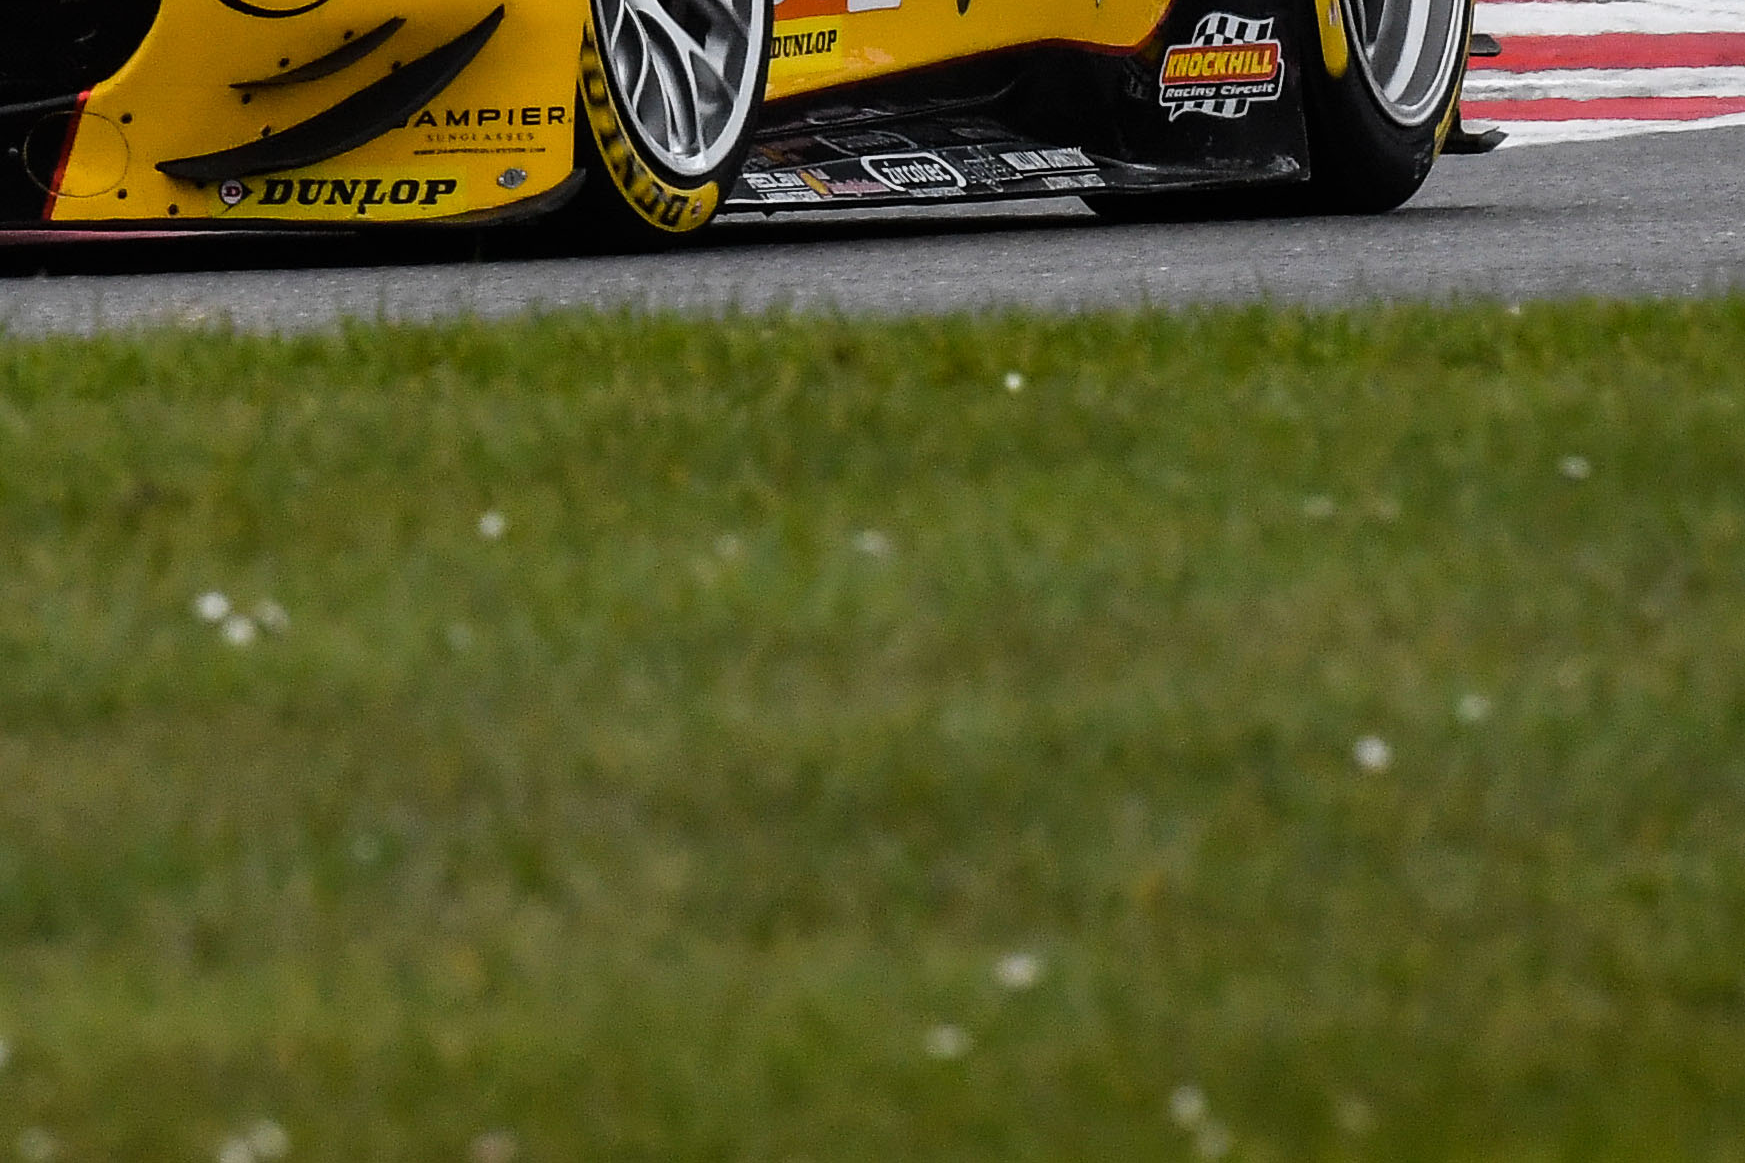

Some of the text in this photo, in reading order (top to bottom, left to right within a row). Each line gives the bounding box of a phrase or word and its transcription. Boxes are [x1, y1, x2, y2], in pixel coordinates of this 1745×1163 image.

[770, 29, 837, 60] DUNLOP
[1164, 49, 1273, 78] KNOCKHILL
[1165, 83, 1276, 98] Racing Circuit
[406, 106, 565, 128] AMPIER
[427, 132, 535, 143] SUNGLASSES
[881, 160, 952, 185] zircotec
[258, 178, 457, 206] DUNLOP
